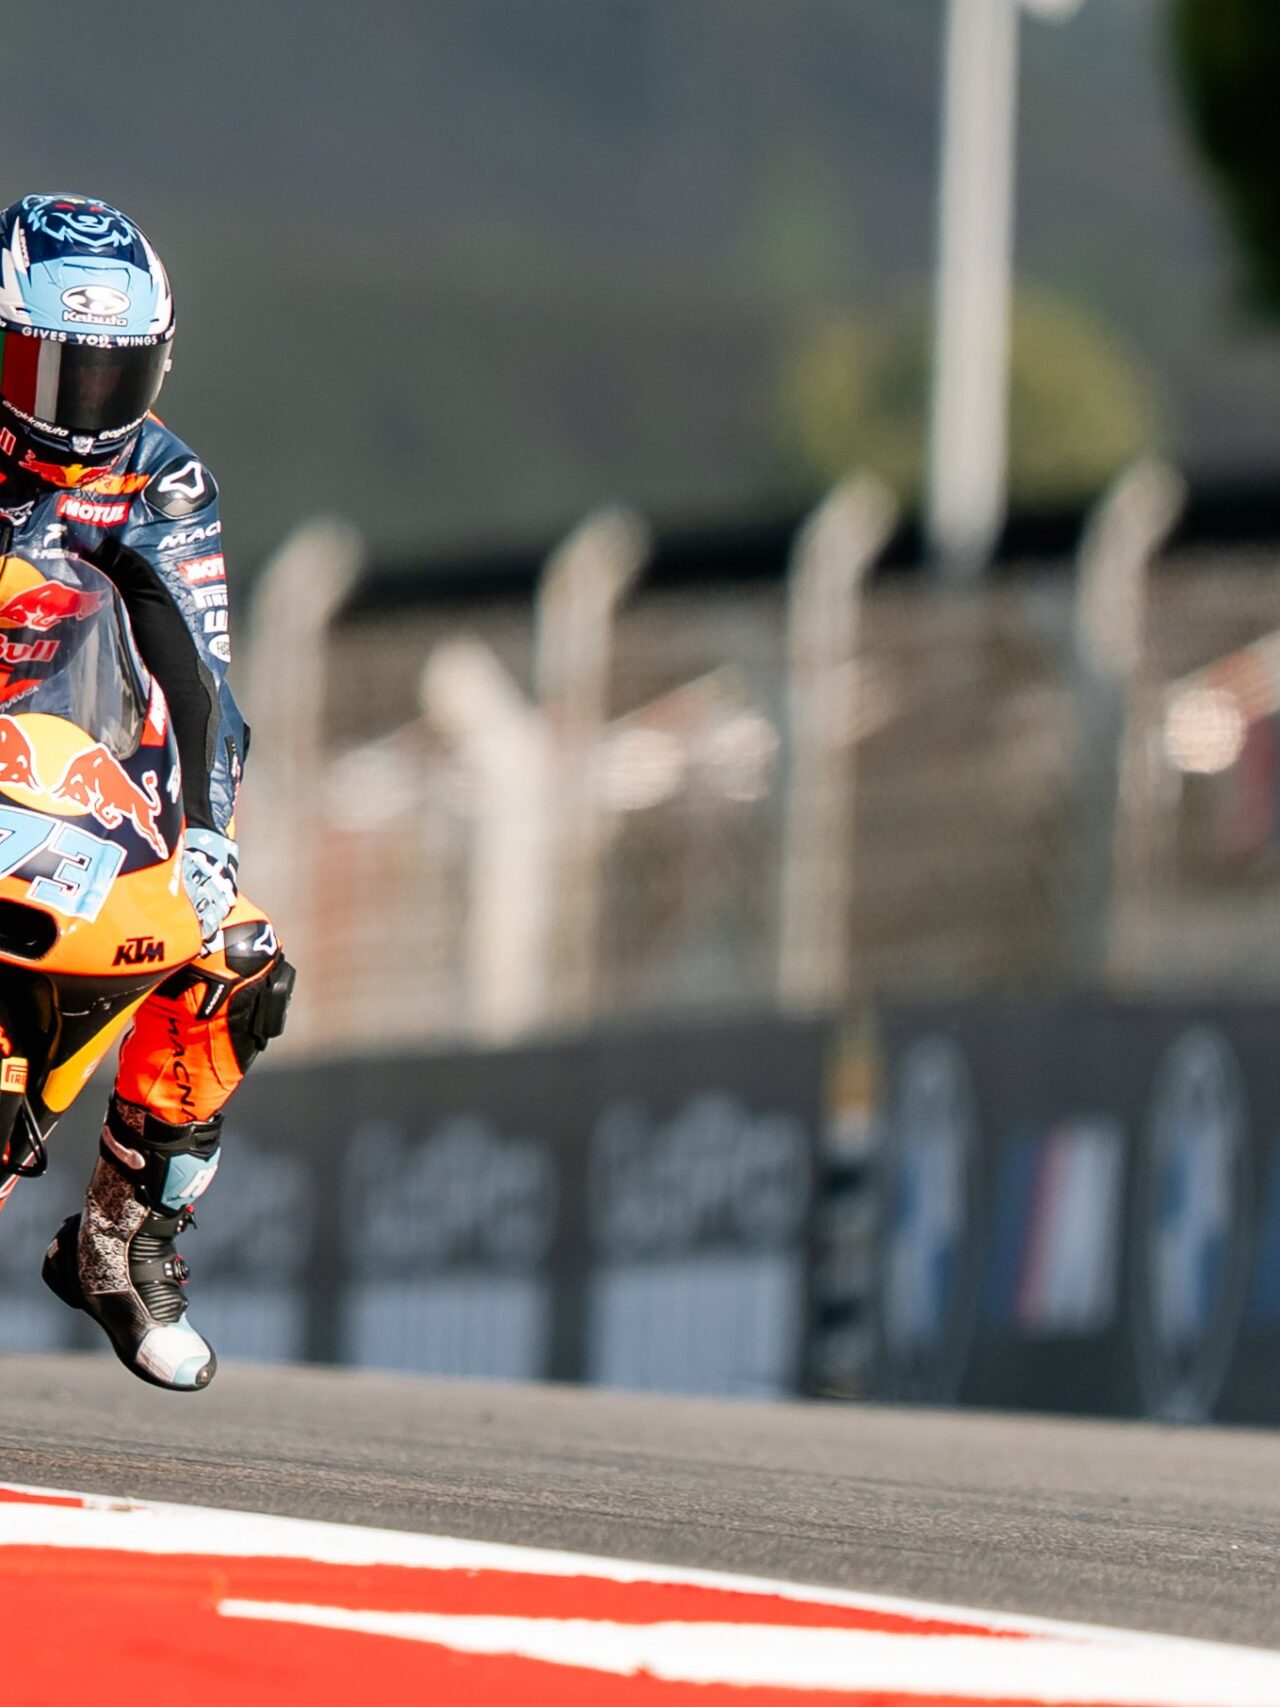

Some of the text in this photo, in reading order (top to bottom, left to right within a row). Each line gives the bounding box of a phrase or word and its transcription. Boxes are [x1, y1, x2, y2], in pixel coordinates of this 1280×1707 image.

[62, 310, 127, 327] Kabuto
[21, 326, 68, 343] GIVES
[116, 335, 158, 347] WINGS
[60, 498, 126, 524] MOTUL
[112, 936, 165, 967] KTM
